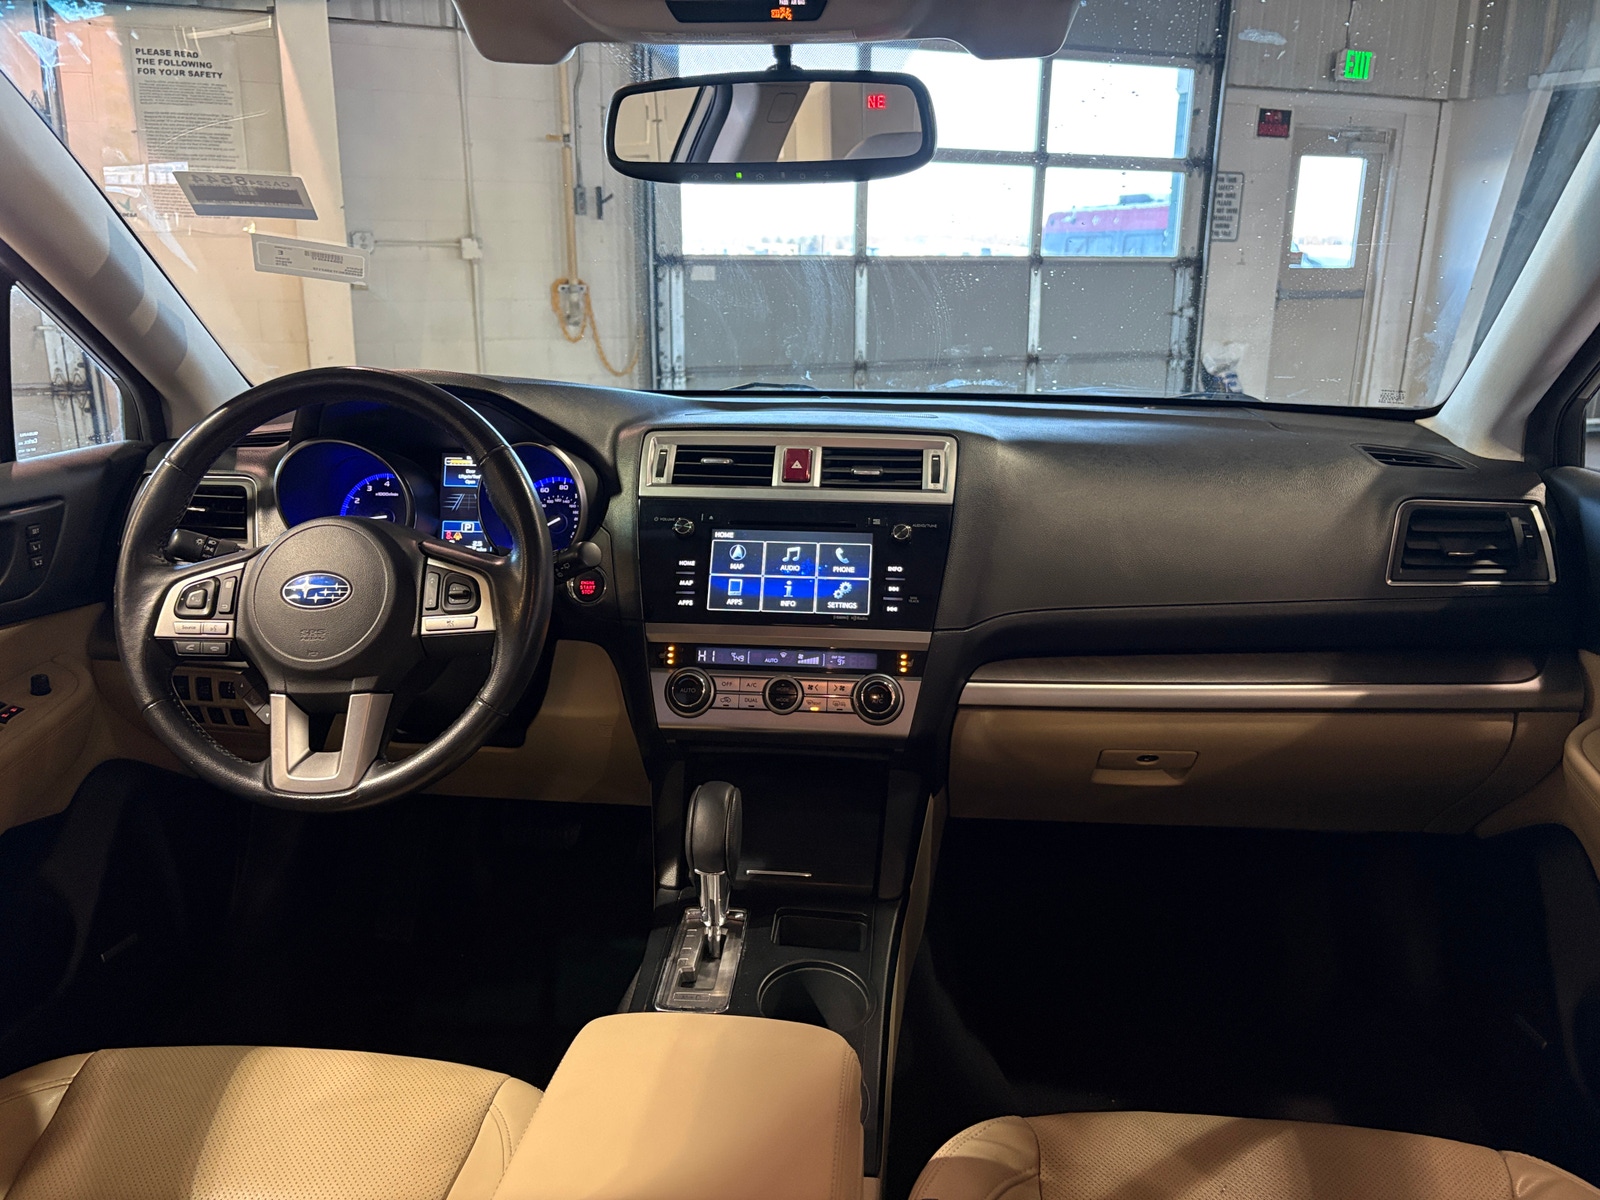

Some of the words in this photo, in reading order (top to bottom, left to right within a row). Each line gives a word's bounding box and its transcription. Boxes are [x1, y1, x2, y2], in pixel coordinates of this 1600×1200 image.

[135, 48, 171, 57] PLEASE
[174, 50, 199, 58] READ
[158, 59, 212, 69] FOLLOWING
[1344, 50, 1372, 79] EXIT
[159, 69, 186, 77] YOUR
[188, 70, 223, 79] SAFETY
[867, 95, 886, 109] NE
[714, 531, 734, 539] HOME
[780, 564, 801, 572] AUDIO
[832, 566, 855, 574] PHONE
[726, 598, 743, 606] APPS
[780, 600, 797, 608] INFO
[827, 601, 858, 610] SETTINGS
